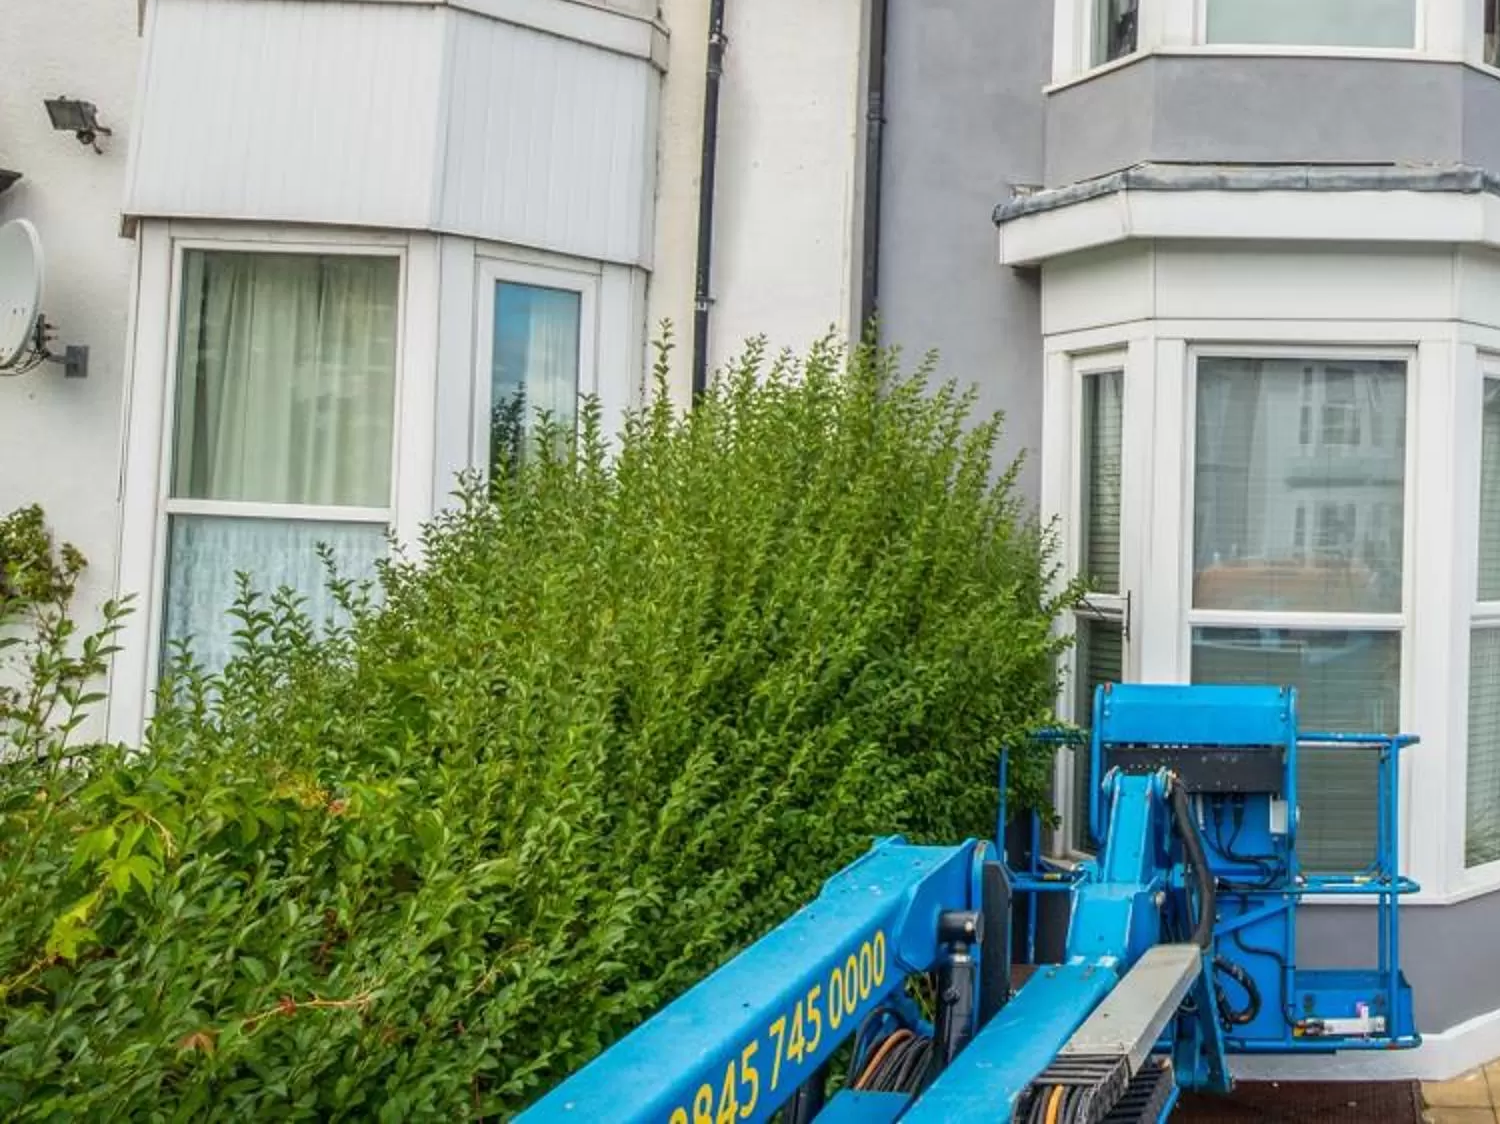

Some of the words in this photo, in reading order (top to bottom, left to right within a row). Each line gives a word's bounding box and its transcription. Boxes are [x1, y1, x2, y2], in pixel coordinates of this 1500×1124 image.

[668, 1039, 759, 1124] 845
[769, 984, 821, 1092] 745
[828, 929, 885, 1030] 0000
